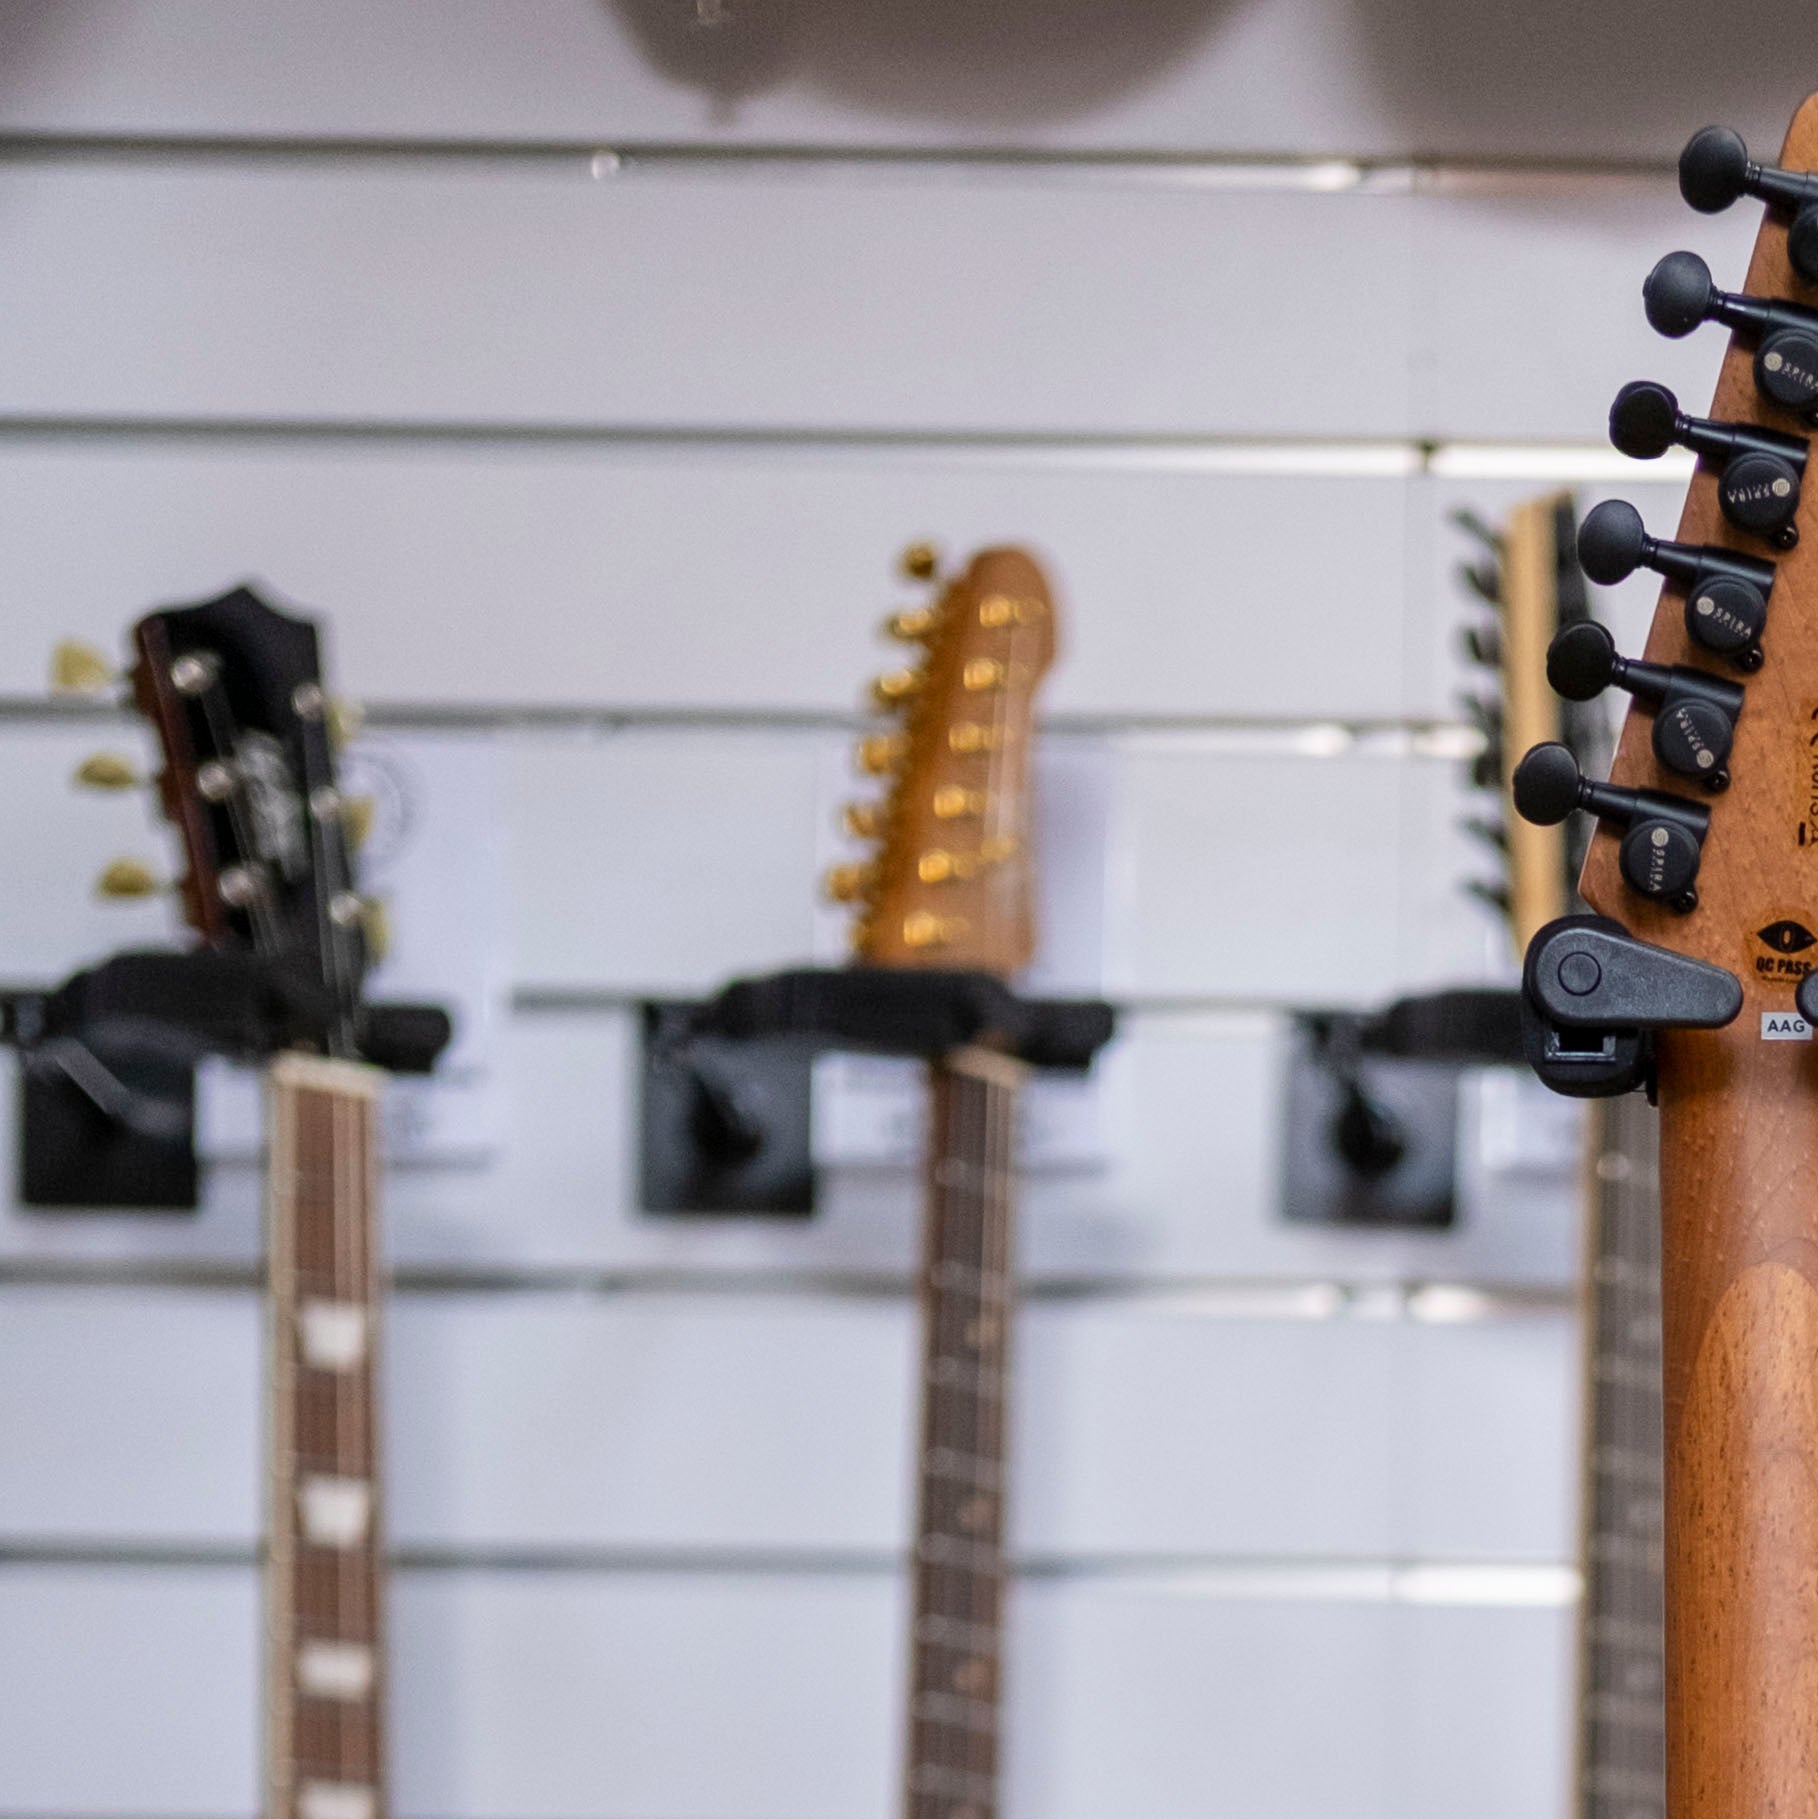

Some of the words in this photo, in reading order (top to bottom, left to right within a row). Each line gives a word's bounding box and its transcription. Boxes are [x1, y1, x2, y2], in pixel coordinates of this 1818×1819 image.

[1727, 486, 1770, 503] SPIRA
[1715, 607, 1752, 639] SPIRA
[1675, 708, 1702, 751] SPIRA
[1756, 957, 1774, 973] QC
[1777, 959, 1812, 976] PASS
[1767, 1020, 1805, 1032] AAG
